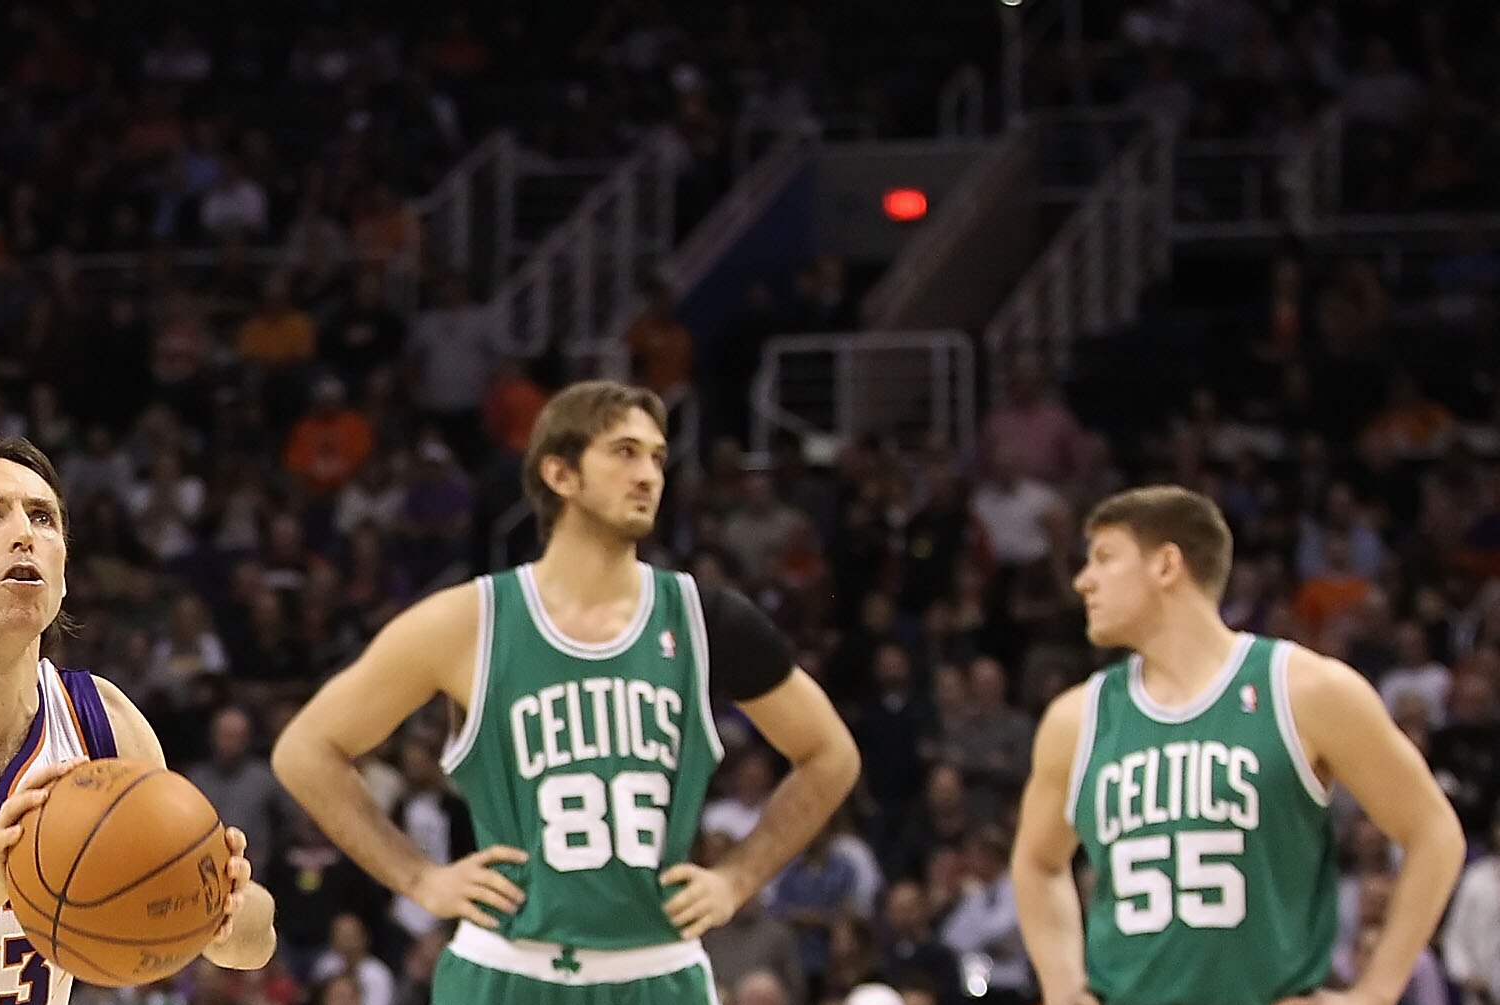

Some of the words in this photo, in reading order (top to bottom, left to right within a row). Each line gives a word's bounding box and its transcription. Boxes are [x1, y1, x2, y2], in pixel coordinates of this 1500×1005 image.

[510, 677, 682, 780] CELTICS
[538, 772, 671, 872] 86
[1095, 741, 1260, 845] CELTICS
[1111, 828, 1247, 936] 55
